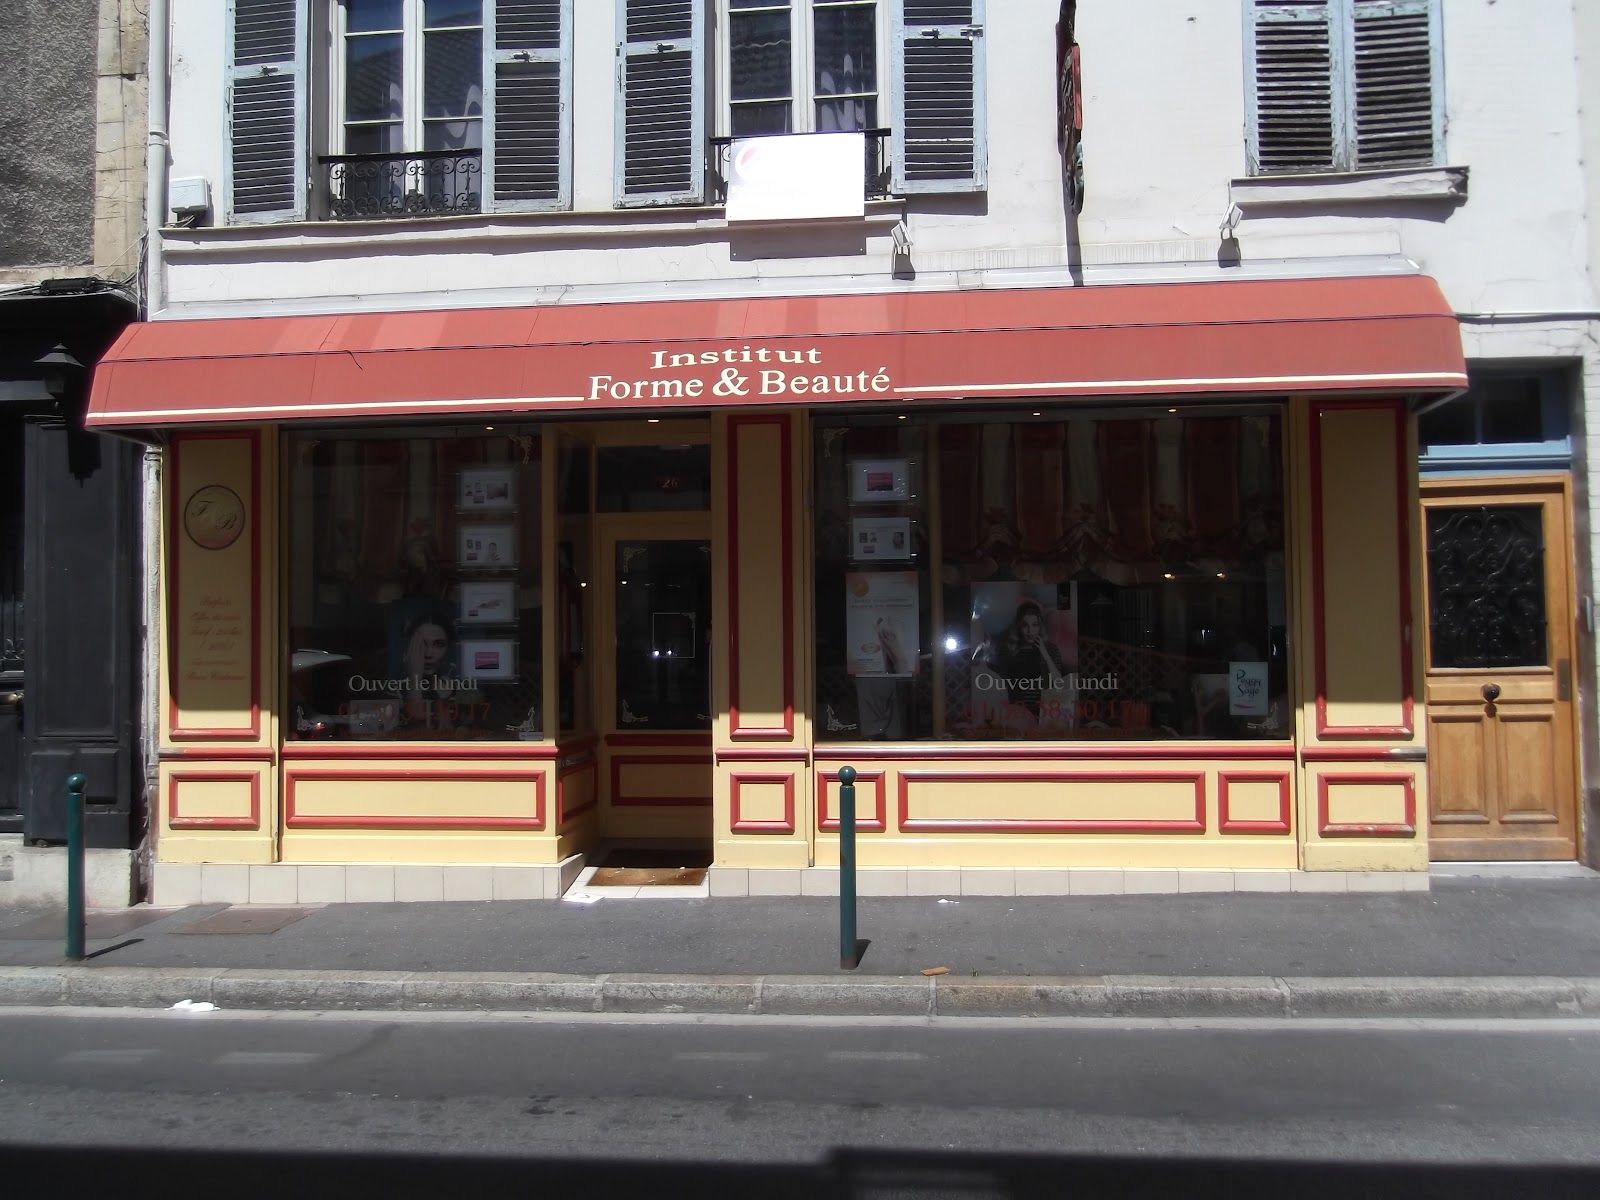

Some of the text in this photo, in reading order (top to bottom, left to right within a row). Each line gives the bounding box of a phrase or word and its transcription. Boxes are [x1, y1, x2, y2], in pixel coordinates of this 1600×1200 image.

[650, 345, 822, 369] Institut
[587, 366, 891, 401] Forme & Beauté
[348, 673, 478, 692] Ouvert le lundi
[974, 672, 1119, 691] Ouvert le lundi
[1236, 669, 1261, 688] Peggy
[1236, 684, 1260, 698] Sage
